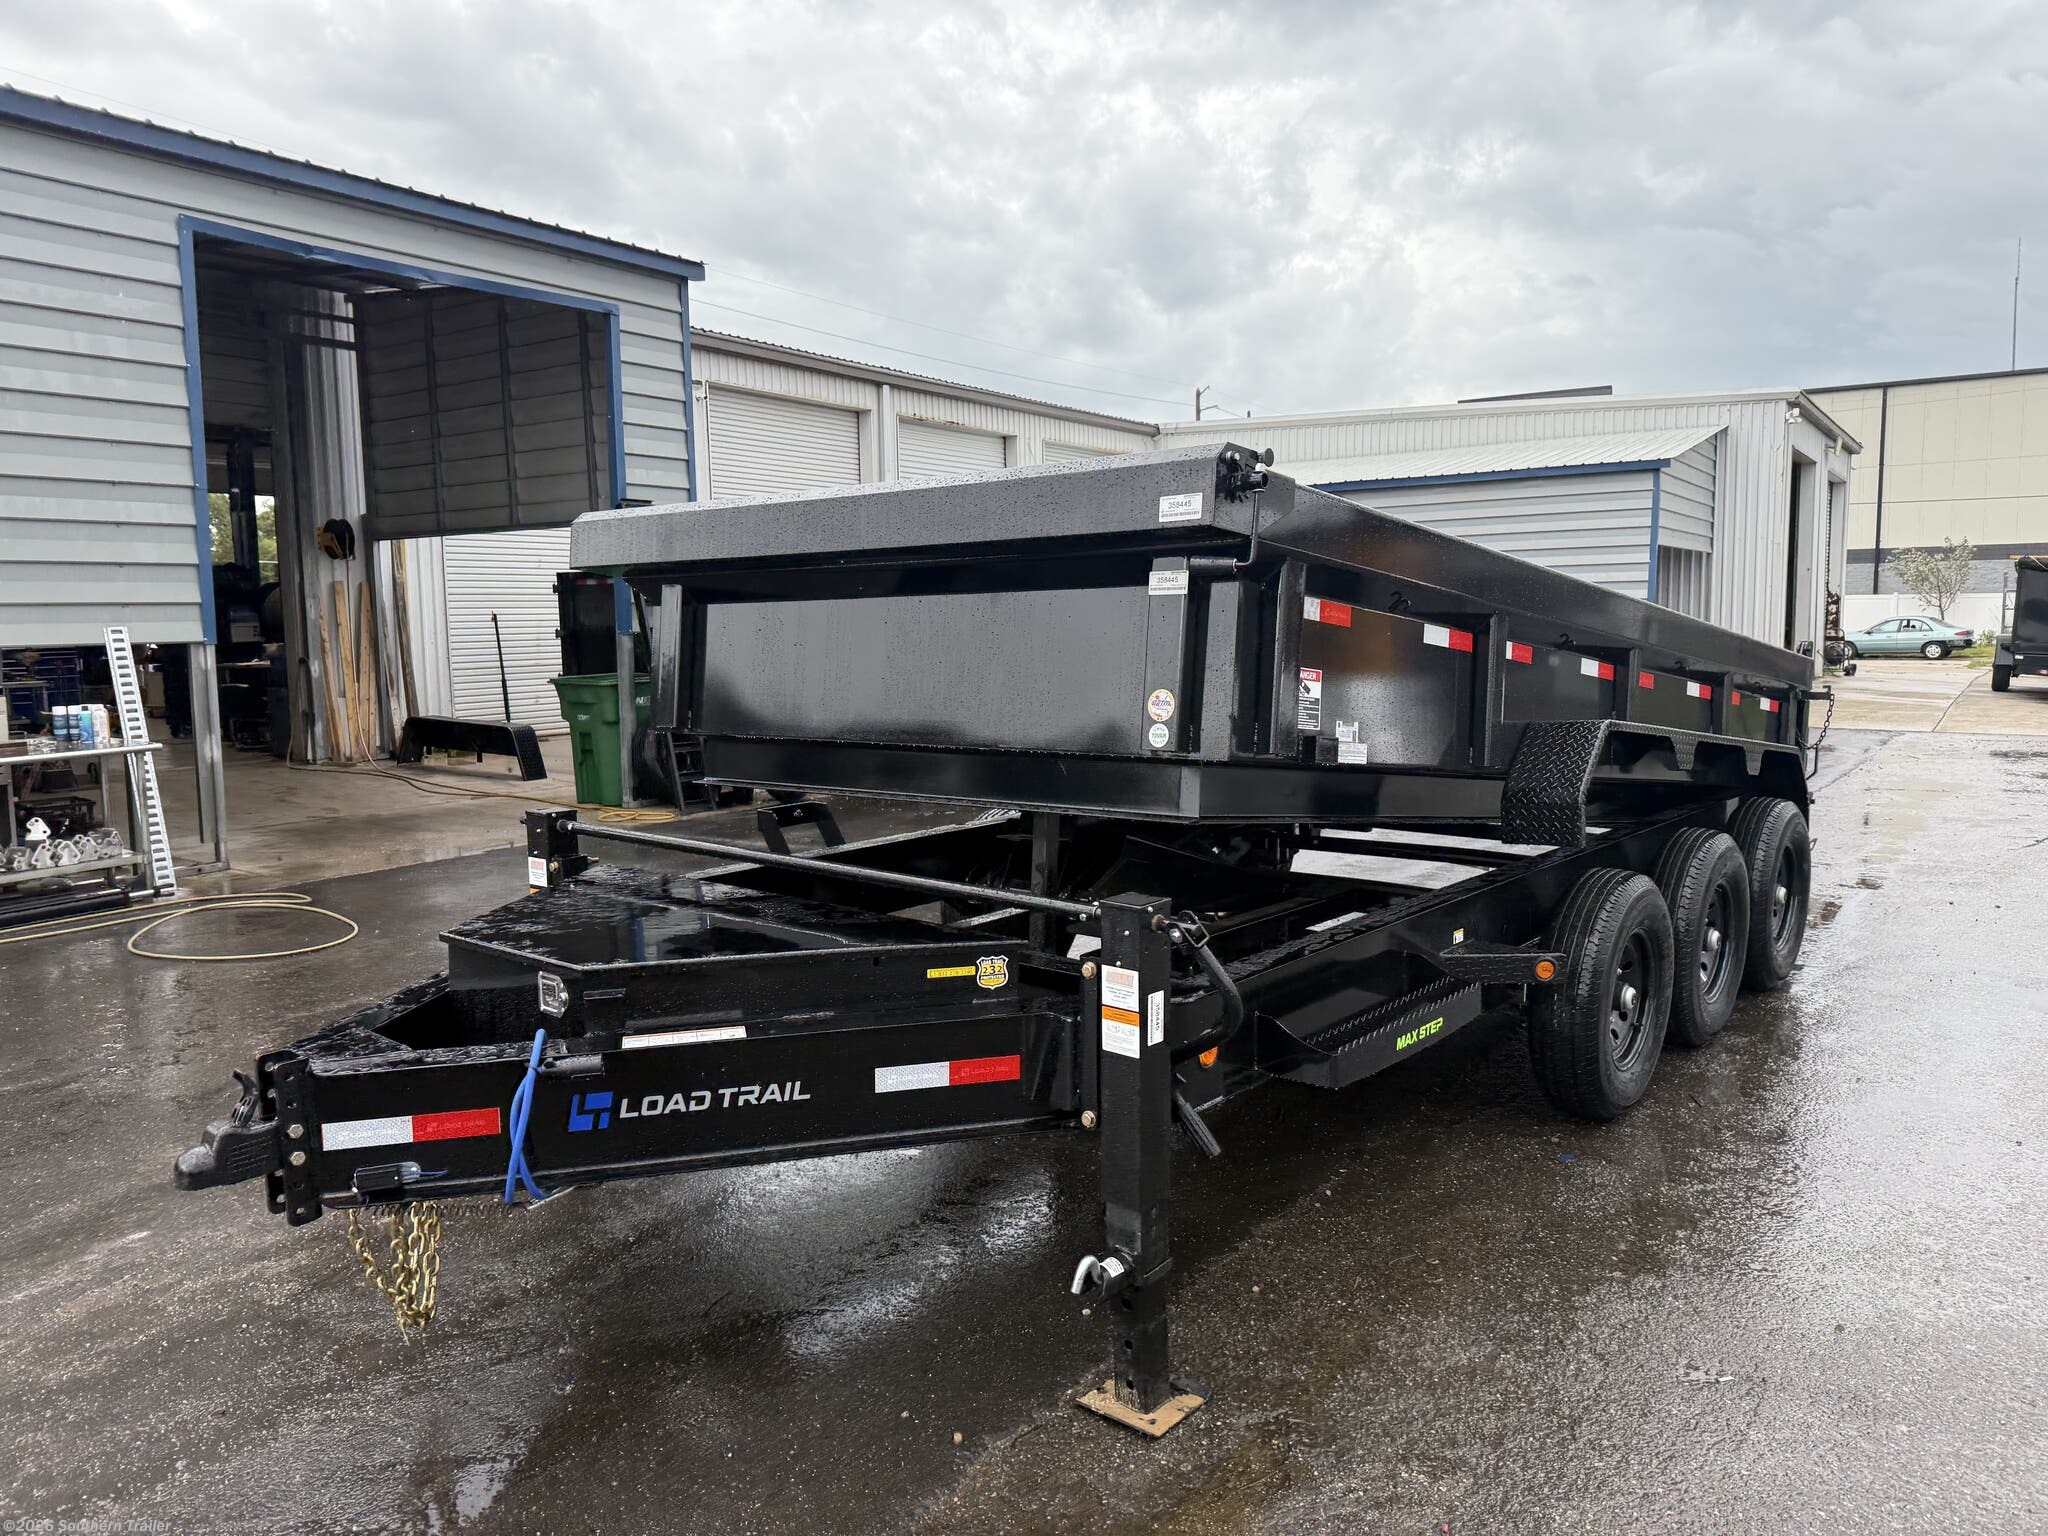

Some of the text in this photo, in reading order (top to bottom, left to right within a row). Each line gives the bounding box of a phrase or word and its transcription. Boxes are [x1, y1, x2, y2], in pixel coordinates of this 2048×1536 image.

[1167, 500, 1192, 509] 358445
[1300, 671, 1317, 680] ANGER
[983, 965, 1002, 974] 232
[1396, 1017, 1443, 1051] MAX STEP
[619, 1081, 811, 1118] LOAD TRAIL
